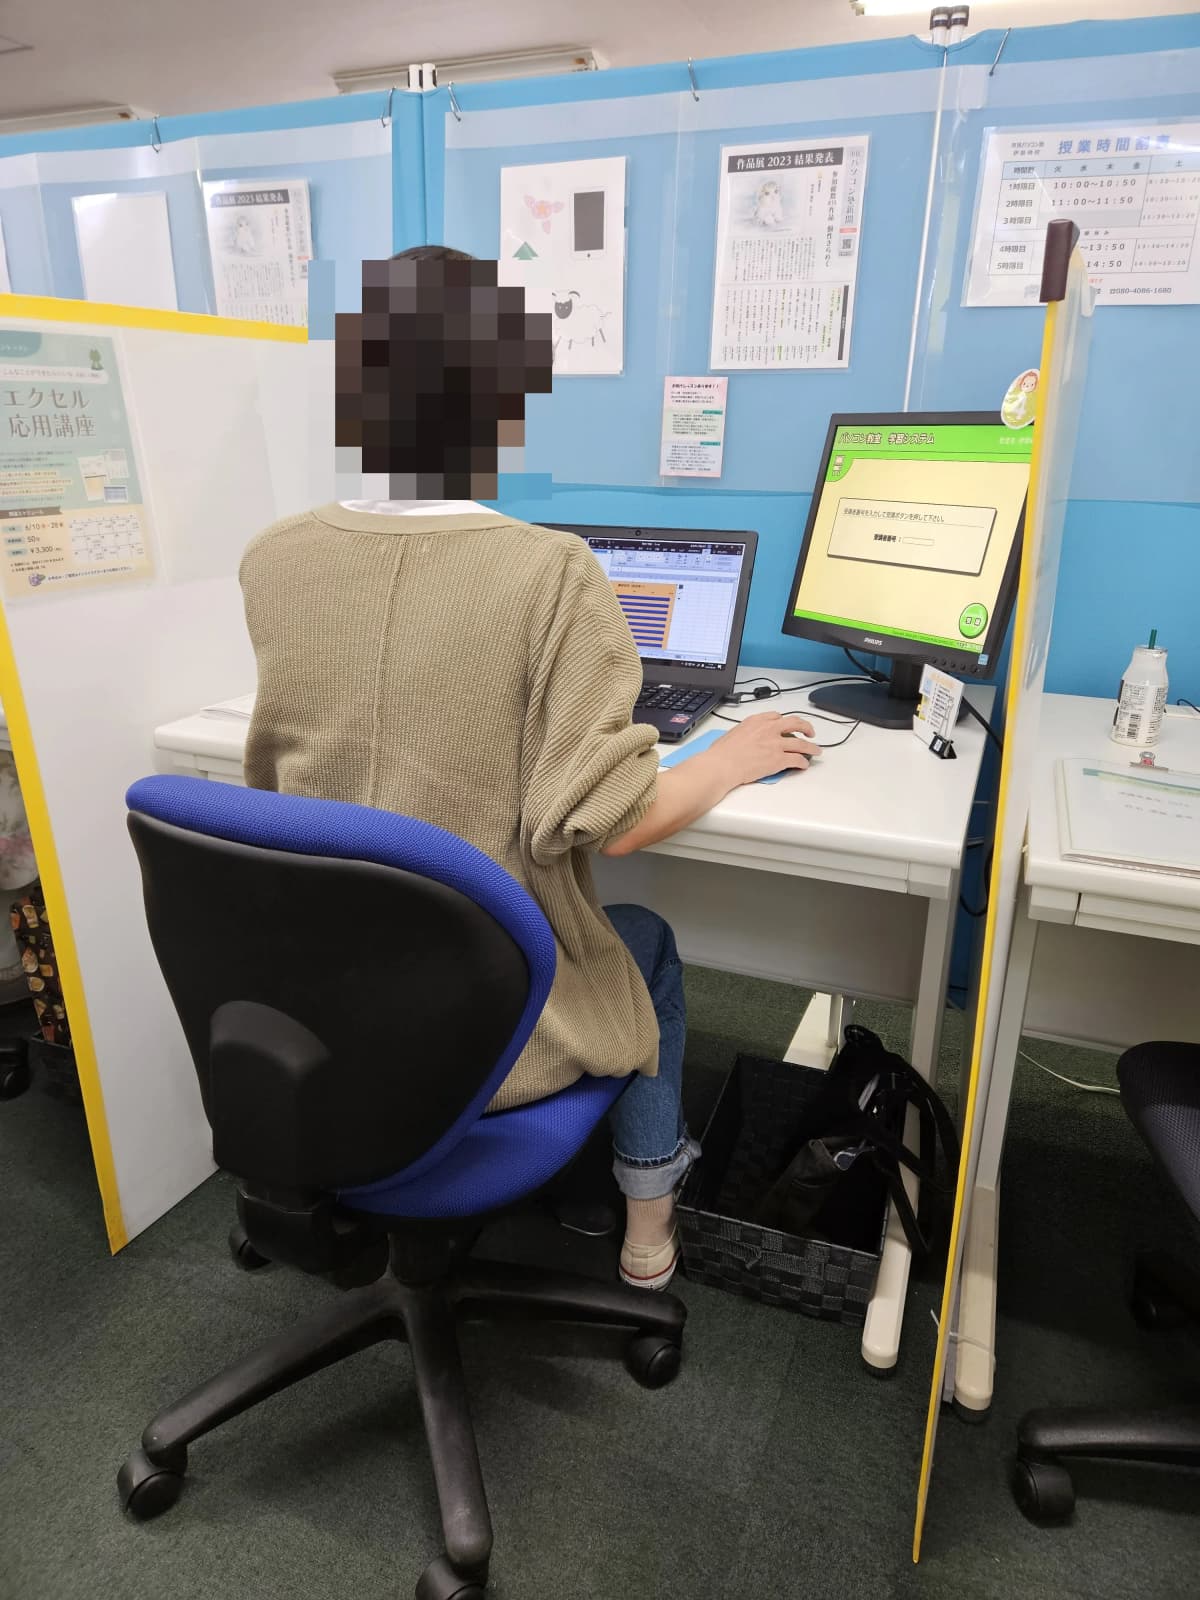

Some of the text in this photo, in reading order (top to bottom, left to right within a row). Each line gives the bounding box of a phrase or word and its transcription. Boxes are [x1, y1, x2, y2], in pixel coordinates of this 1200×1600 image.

[736, 152, 834, 170] 作品展 2023 結果発表
[1175, 160, 1183, 168] 土
[3, 387, 91, 409] エクセル
[8, 413, 97, 438] 応用講座
[887, 431, 936, 445] 学習システム
